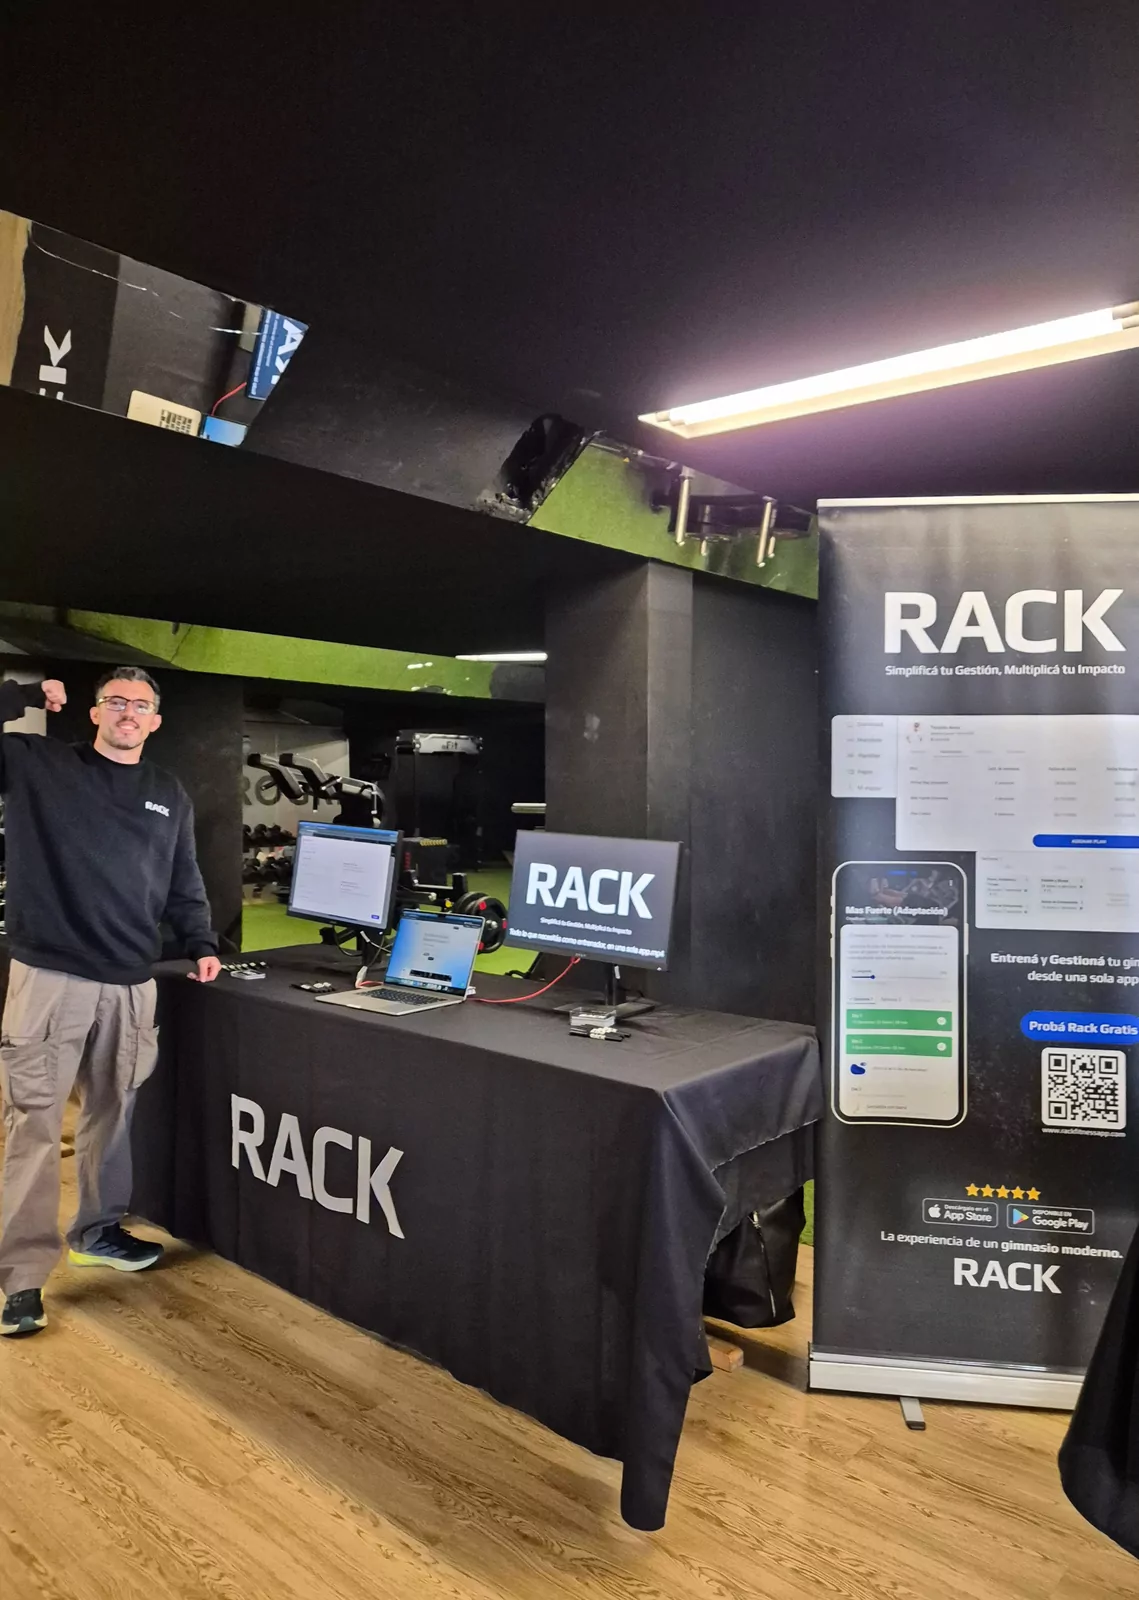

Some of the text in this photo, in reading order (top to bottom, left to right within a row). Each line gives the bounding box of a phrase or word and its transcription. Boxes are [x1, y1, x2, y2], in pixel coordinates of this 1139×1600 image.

[885, 589, 1127, 653] RACK
[885, 665, 1126, 677] Simplificá tu Gestión, Multiplicá tu Impacto
[145, 801, 170, 817] RACK
[525, 862, 655, 919] RACK
[845, 906, 949, 917] Mas Fuerte (Adaptación)
[509, 928, 522, 937] Todo
[626, 946, 638, 954] sola
[990, 953, 1039, 964] Entrená
[1040, 956, 1048, 966] y
[1049, 955, 1105, 966] Gestioná
[1107, 957, 1121, 967] tu
[1027, 971, 1063, 982] desde
[1065, 974, 1087, 983] una
[1090, 973, 1114, 983] sola
[1029, 1021, 1139, 1035] Probá Rack Gratis
[231, 1093, 405, 1239] RACK
[943, 1210, 992, 1222] App Store
[1032, 1216, 1089, 1231] Google Play
[881, 1231, 1124, 1258] La experiencia de un gimnasio moderno.
[954, 1257, 1063, 1294] RACK
